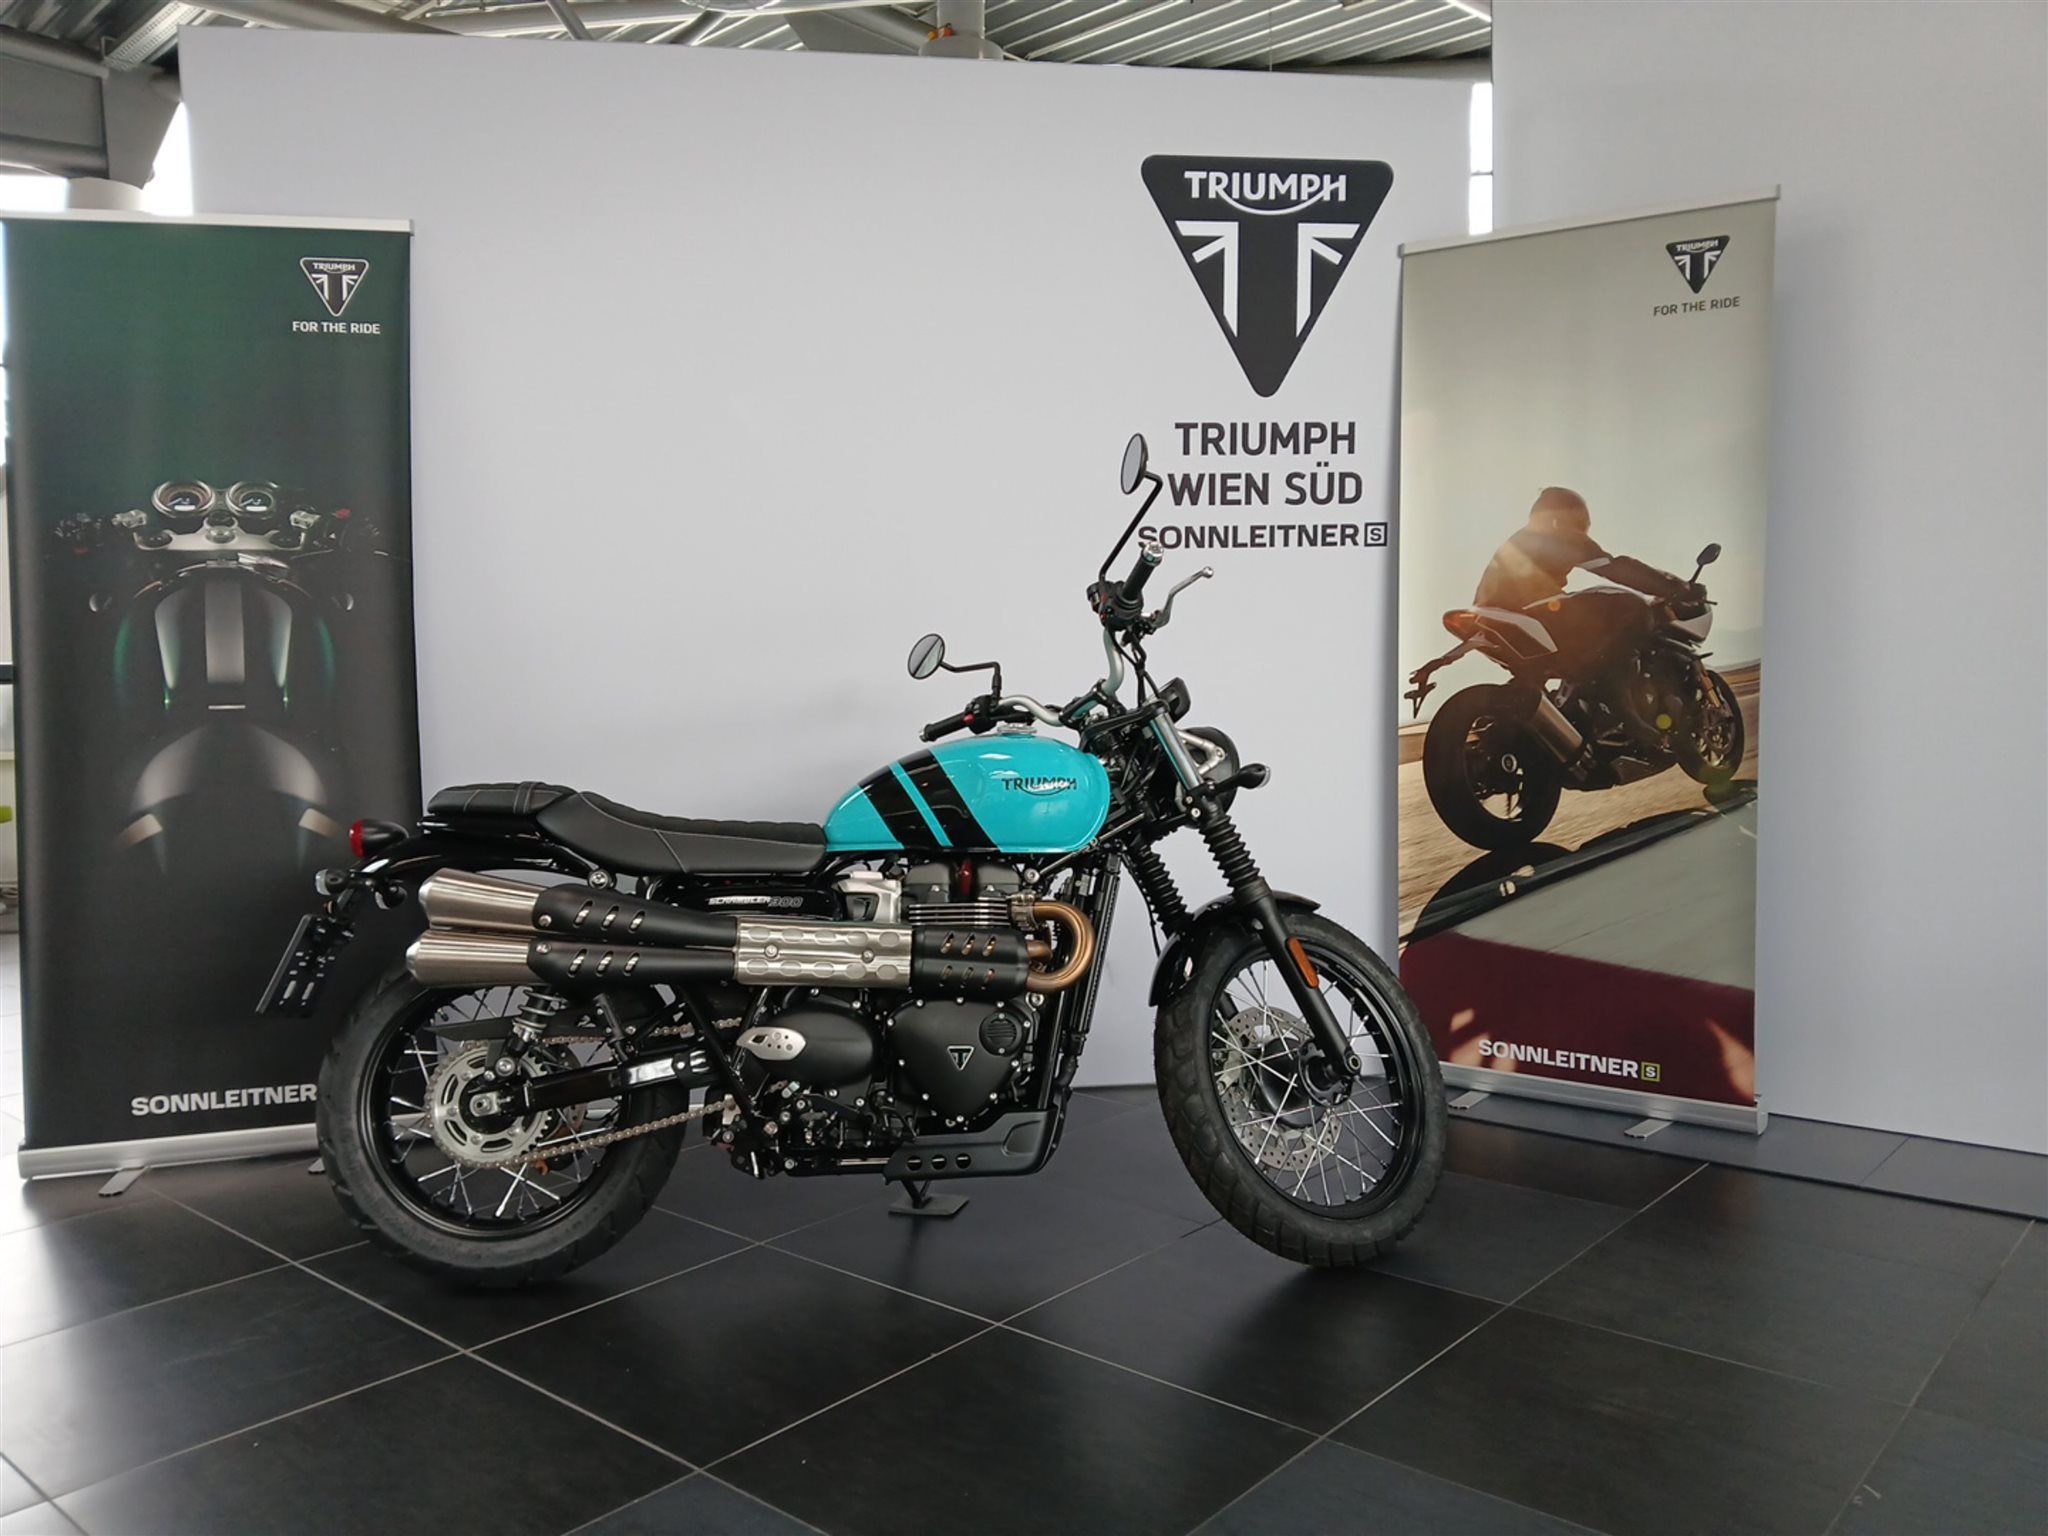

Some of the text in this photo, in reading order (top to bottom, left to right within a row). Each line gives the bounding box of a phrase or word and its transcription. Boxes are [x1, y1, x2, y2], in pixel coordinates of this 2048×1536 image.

[1184, 170, 1347, 214] TRIUMPH
[1675, 239, 1719, 253] TRIUMPH
[312, 262, 356, 273] TRIUMPH
[1653, 296, 1740, 317] FOR THE RIDE
[292, 321, 381, 335] FOR THE RIDE
[1175, 421, 1356, 456] TRIUMPH
[1167, 461, 1363, 506] WIEN SÜD
[1138, 523, 1360, 549] SONNLEITNER
[1001, 776, 1078, 797] TRIUMPH
[1478, 1039, 1639, 1079] SONNLEITNER
[131, 1083, 318, 1116] SONNLEITNER
